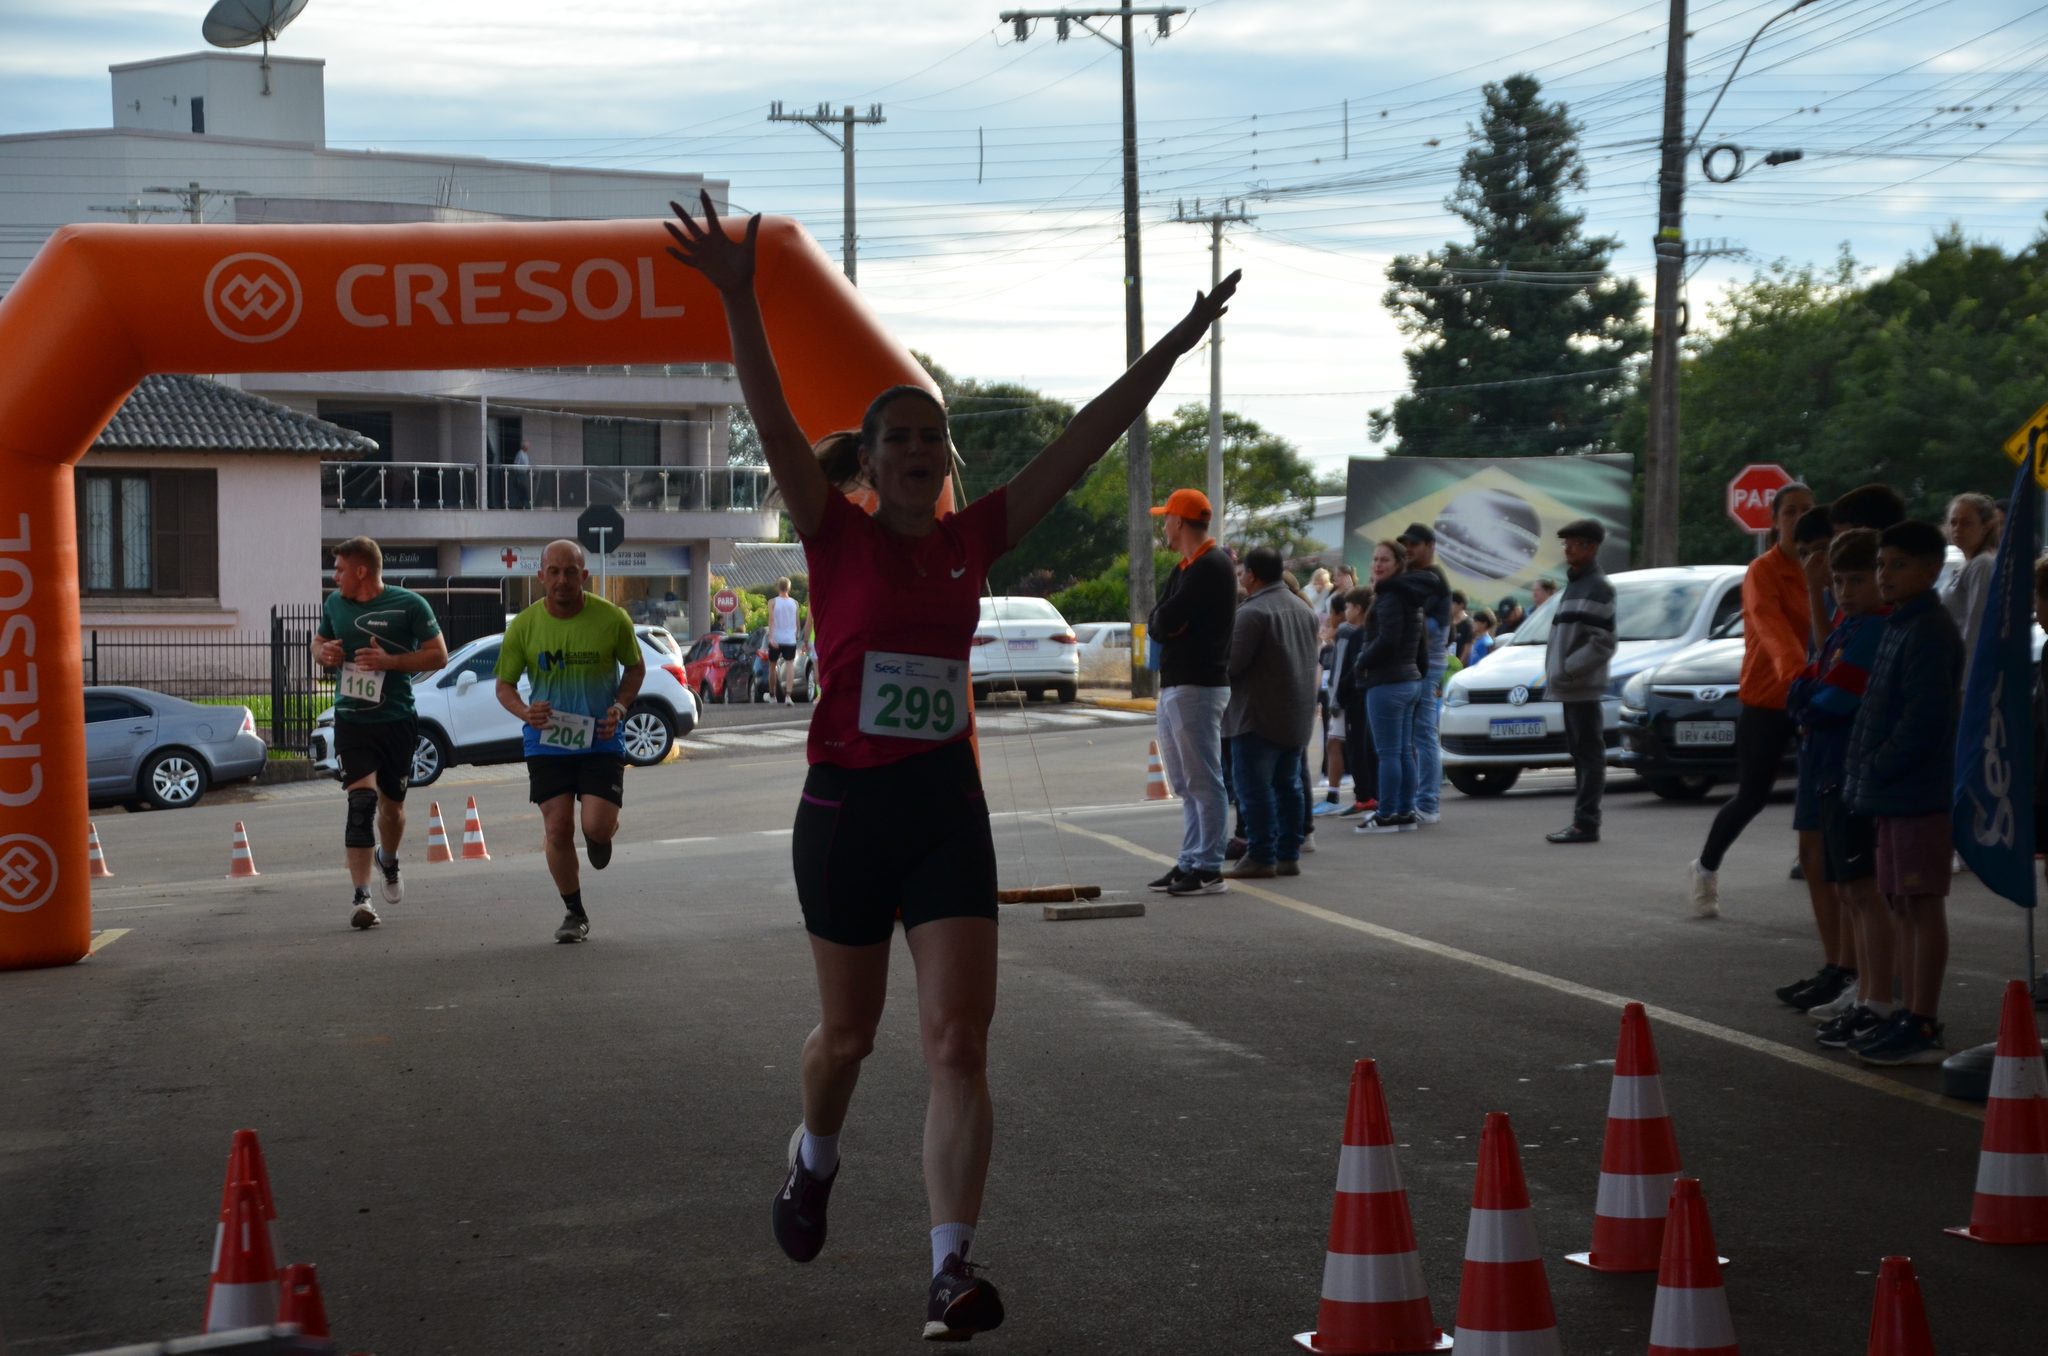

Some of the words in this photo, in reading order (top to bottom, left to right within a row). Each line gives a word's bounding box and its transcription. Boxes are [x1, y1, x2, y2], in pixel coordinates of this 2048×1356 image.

[336, 256, 686, 328] CRESOL
[1734, 488, 1778, 508] PAR
[384, 552, 397, 562] Seu
[399, 552, 420, 562] Estilo
[717, 596, 734, 606] PARE
[0, 512, 44, 808] CRESOL
[346, 675, 376, 698] 116
[873, 682, 956, 733] 299
[547, 723, 586, 748] 204
